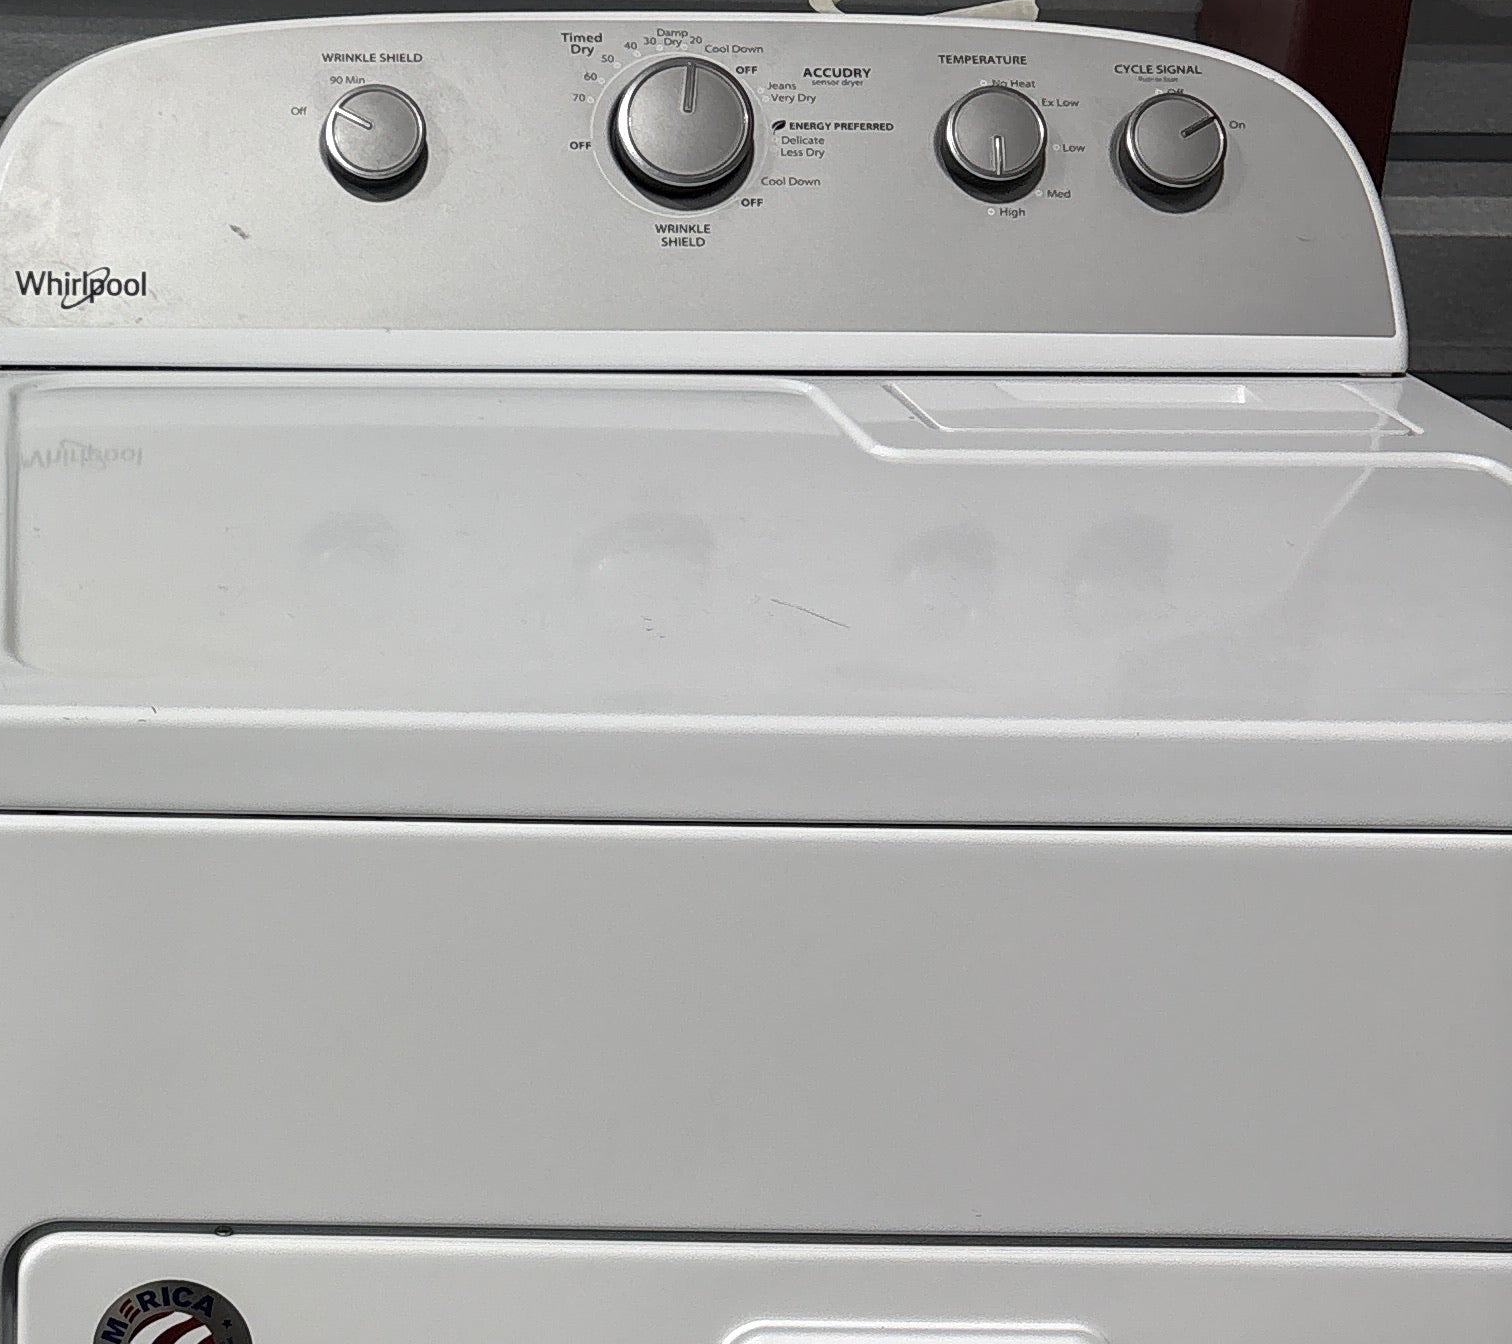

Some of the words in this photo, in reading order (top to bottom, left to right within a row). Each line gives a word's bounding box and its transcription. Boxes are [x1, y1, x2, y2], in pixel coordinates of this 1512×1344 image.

[561, 32, 603, 43] Timed
[656, 28, 688, 39] Damp
[644, 37, 657, 46] 30
[664, 38, 682, 48] Dry
[690, 36, 703, 44] 20
[571, 44, 594, 56] Dry
[624, 42, 637, 50] 40
[704, 45, 729, 53] Cool
[732, 45, 764, 53] Down
[322, 53, 376, 63] WRINKLE
[379, 53, 423, 63] SHIELD
[601, 55, 615, 63] 50
[938, 55, 1027, 65] TEMPERATURE
[736, 66, 758, 75] OFF
[803, 68, 872, 78] ACCUDRY
[1114, 64, 1154, 75] CYCLE
[1156, 64, 1203, 75] SIGNAL
[330, 76, 343, 85] 90
[345, 76, 366, 85] Min
[584, 72, 598, 81] 60
[767, 81, 797, 90] Jeans
[841, 79, 864, 87] dryer
[992, 79, 1007, 87] No
[1010, 79, 1036, 88] Heat
[573, 93, 586, 102] 70
[770, 93, 795, 104] Very
[797, 93, 817, 104] Dry
[1041, 98, 1053, 107] Ex
[1057, 98, 1080, 107] Low
[291, 106, 307, 116] Off
[789, 122, 832, 131] ENERGY
[834, 122, 894, 131] PREFERRED
[1229, 120, 1246, 129] On
[781, 136, 825, 145] Delicate
[569, 141, 592, 150] OFF
[1062, 144, 1086, 153] Low
[780, 148, 803, 157] Less
[806, 148, 825, 159] Dry
[761, 176, 786, 186] Cool
[788, 177, 821, 186] Down
[1047, 190, 1071, 198] Med
[741, 198, 764, 207] OFF
[999, 208, 1026, 218] High
[655, 224, 711, 235] WRINKLE
[661, 236, 706, 247] SHIELD
[15, 267, 147, 309] Whirlpool
